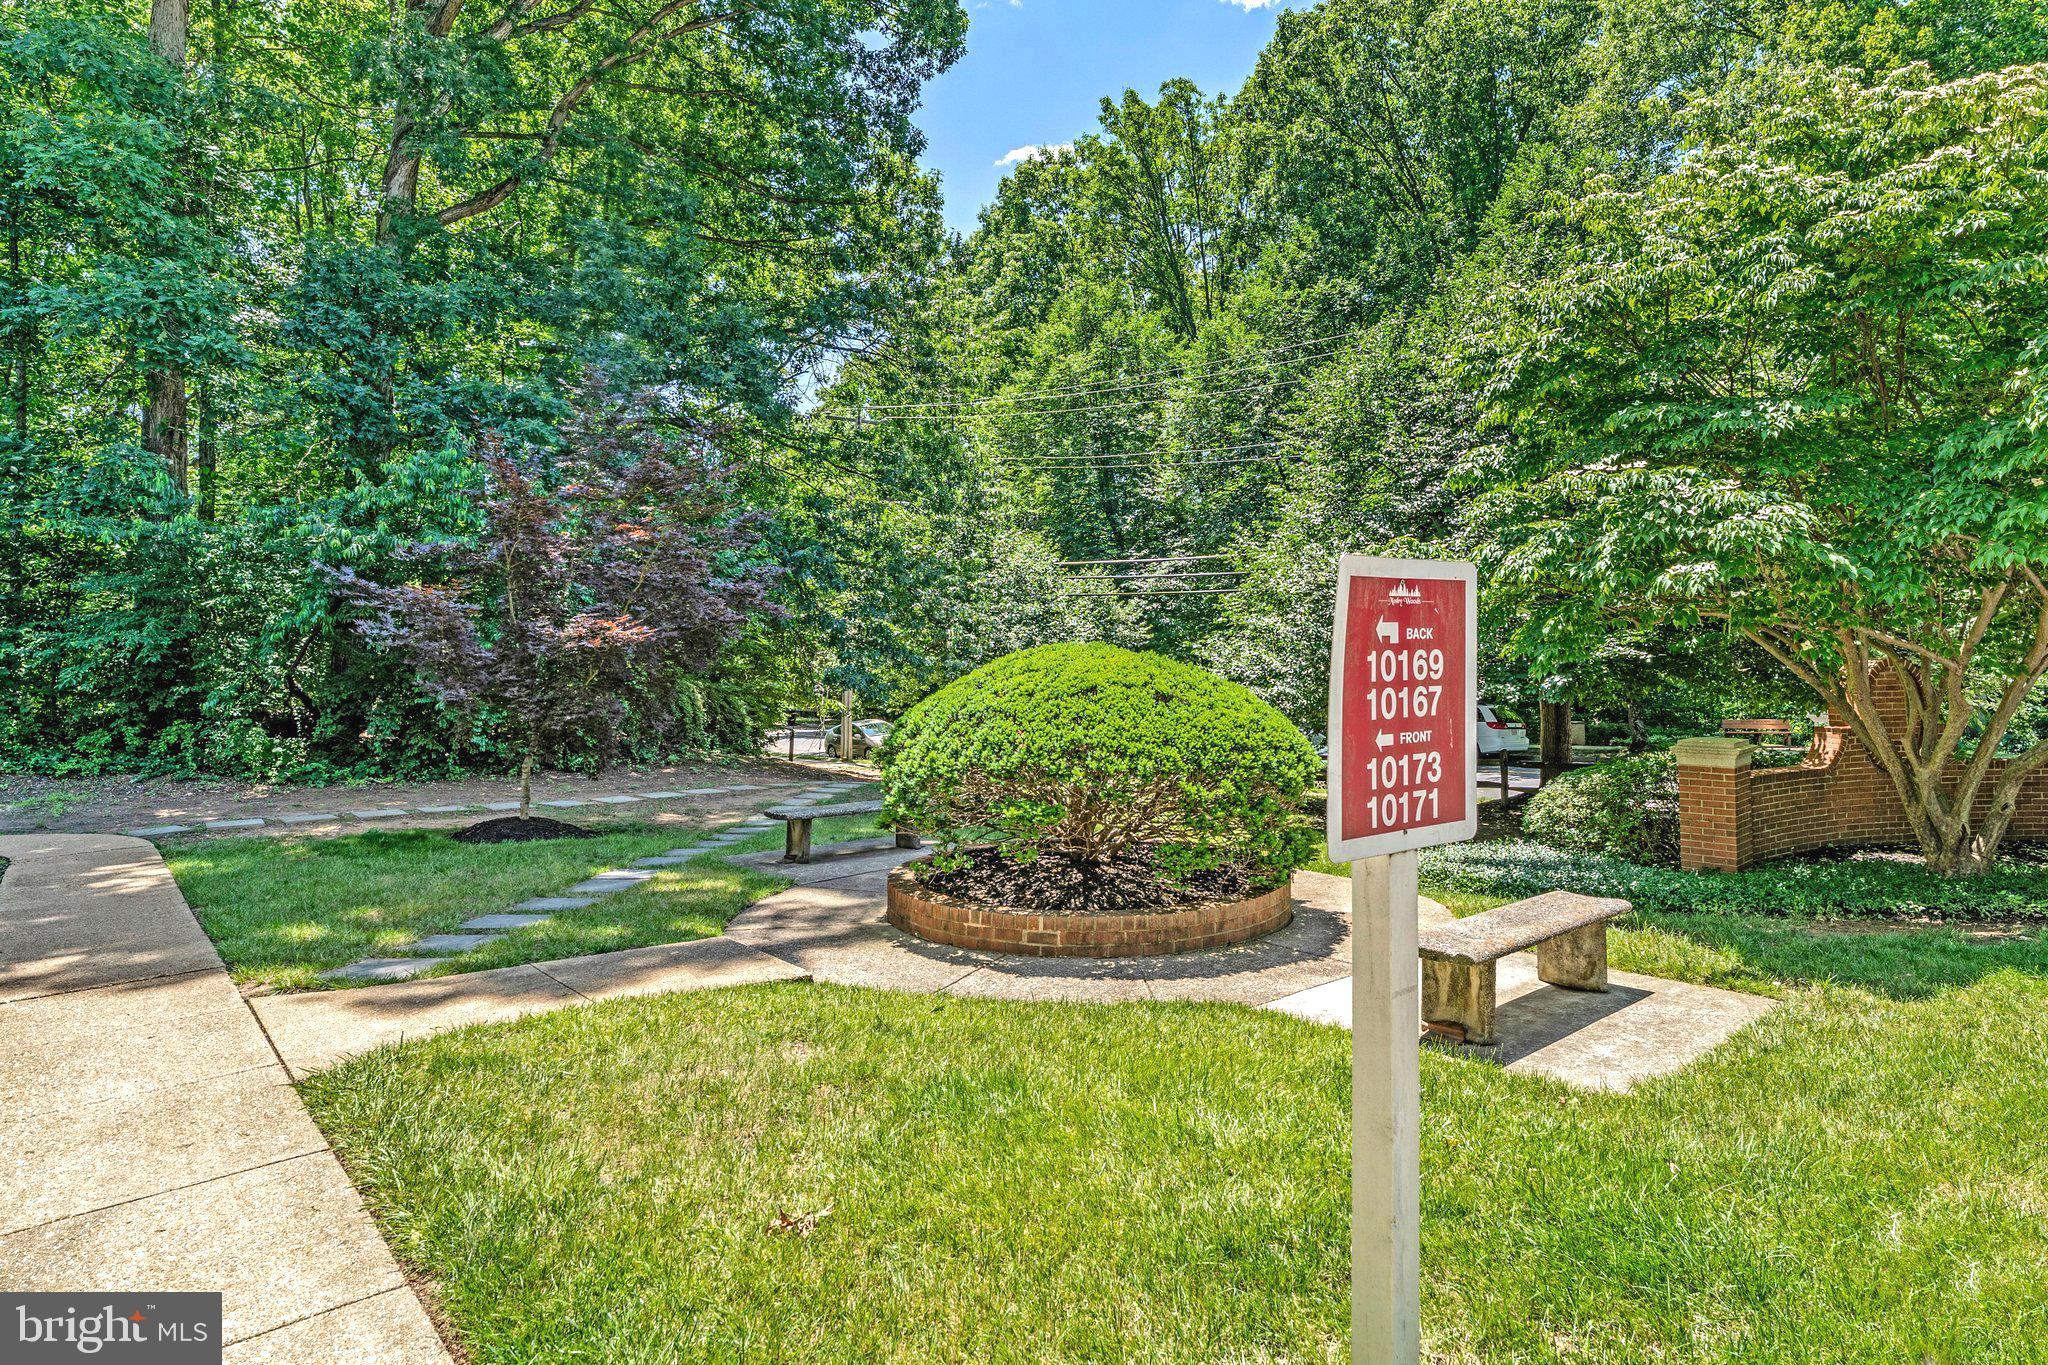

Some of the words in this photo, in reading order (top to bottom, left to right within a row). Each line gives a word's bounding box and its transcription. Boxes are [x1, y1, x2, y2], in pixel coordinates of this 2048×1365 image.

[1406, 628, 1433, 640] BACK
[1367, 649, 1444, 682] 10169
[1367, 685, 1443, 721] 10167
[1399, 730, 1432, 745] FRONT
[1367, 751, 1442, 790] 10173
[1367, 788, 1439, 829] 10171
